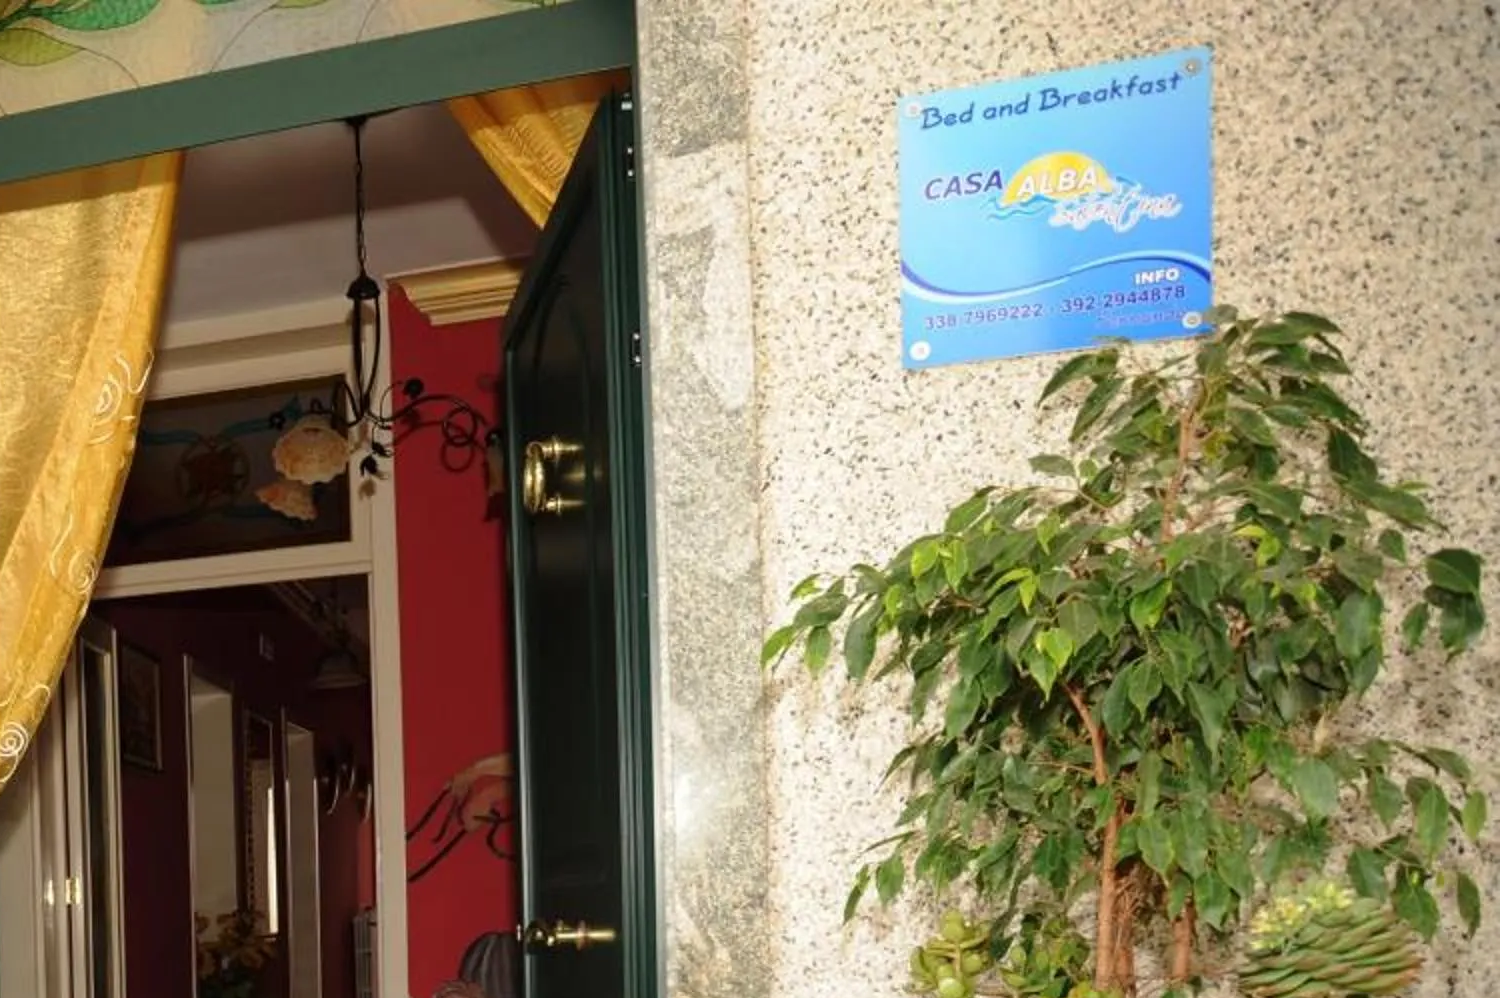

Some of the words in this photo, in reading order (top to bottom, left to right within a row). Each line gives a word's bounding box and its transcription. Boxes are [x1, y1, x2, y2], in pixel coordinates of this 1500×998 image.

[920, 102, 975, 130] Bed
[983, 93, 1032, 120] and
[1038, 71, 1183, 112] Breakfast
[924, 169, 1004, 201] CASA
[1016, 167, 1098, 199] ALBA
[1134, 267, 1181, 286] INFO
